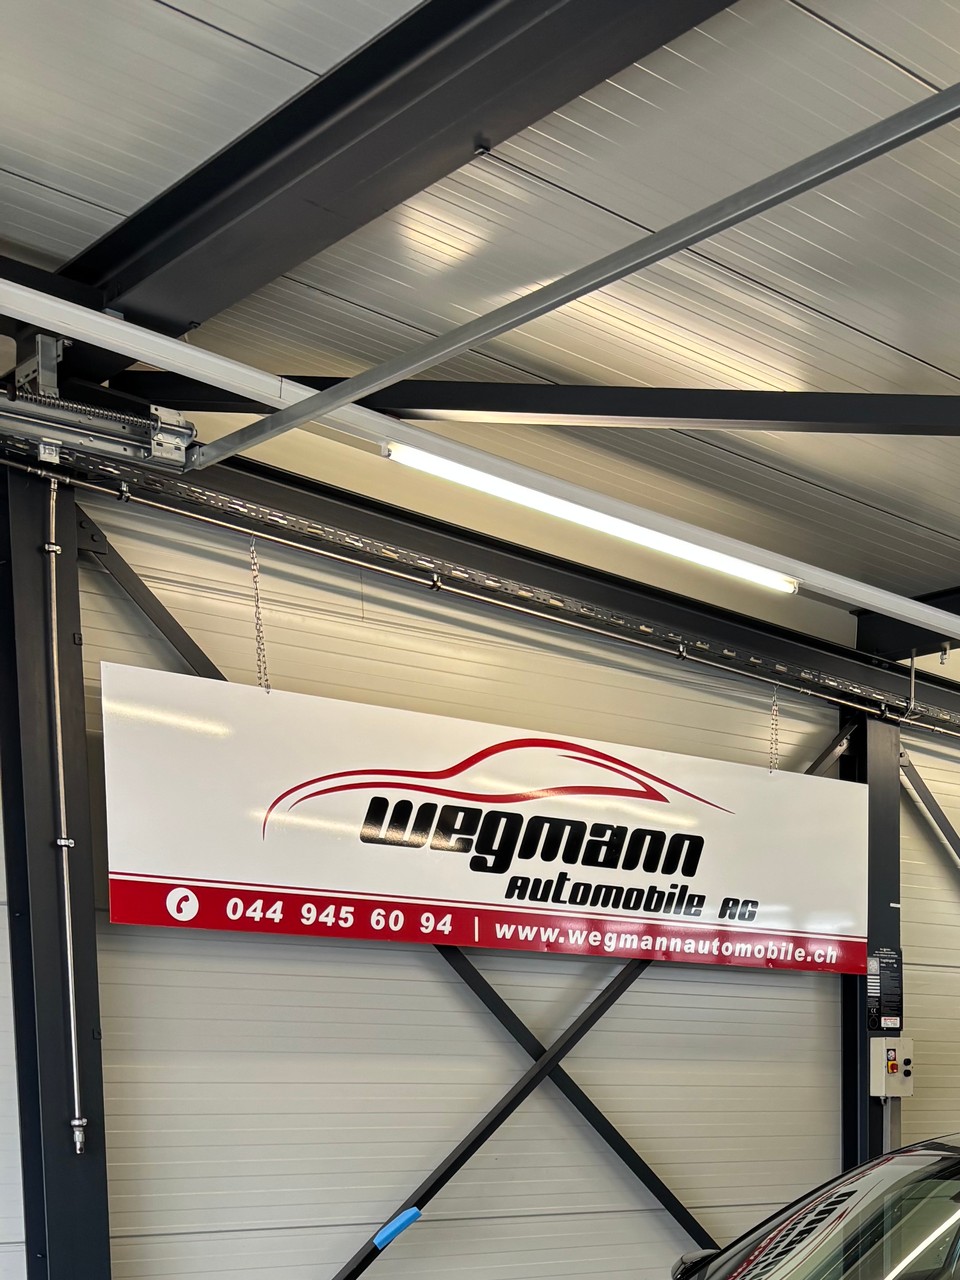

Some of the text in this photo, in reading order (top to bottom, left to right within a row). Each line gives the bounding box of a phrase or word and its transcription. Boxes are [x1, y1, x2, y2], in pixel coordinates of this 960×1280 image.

[360, 796, 705, 877] wegmann
[226, 897, 838, 964] 044 945 60 94 www.wegmannautomobile.ch
[717, 897, 759, 923] AG
